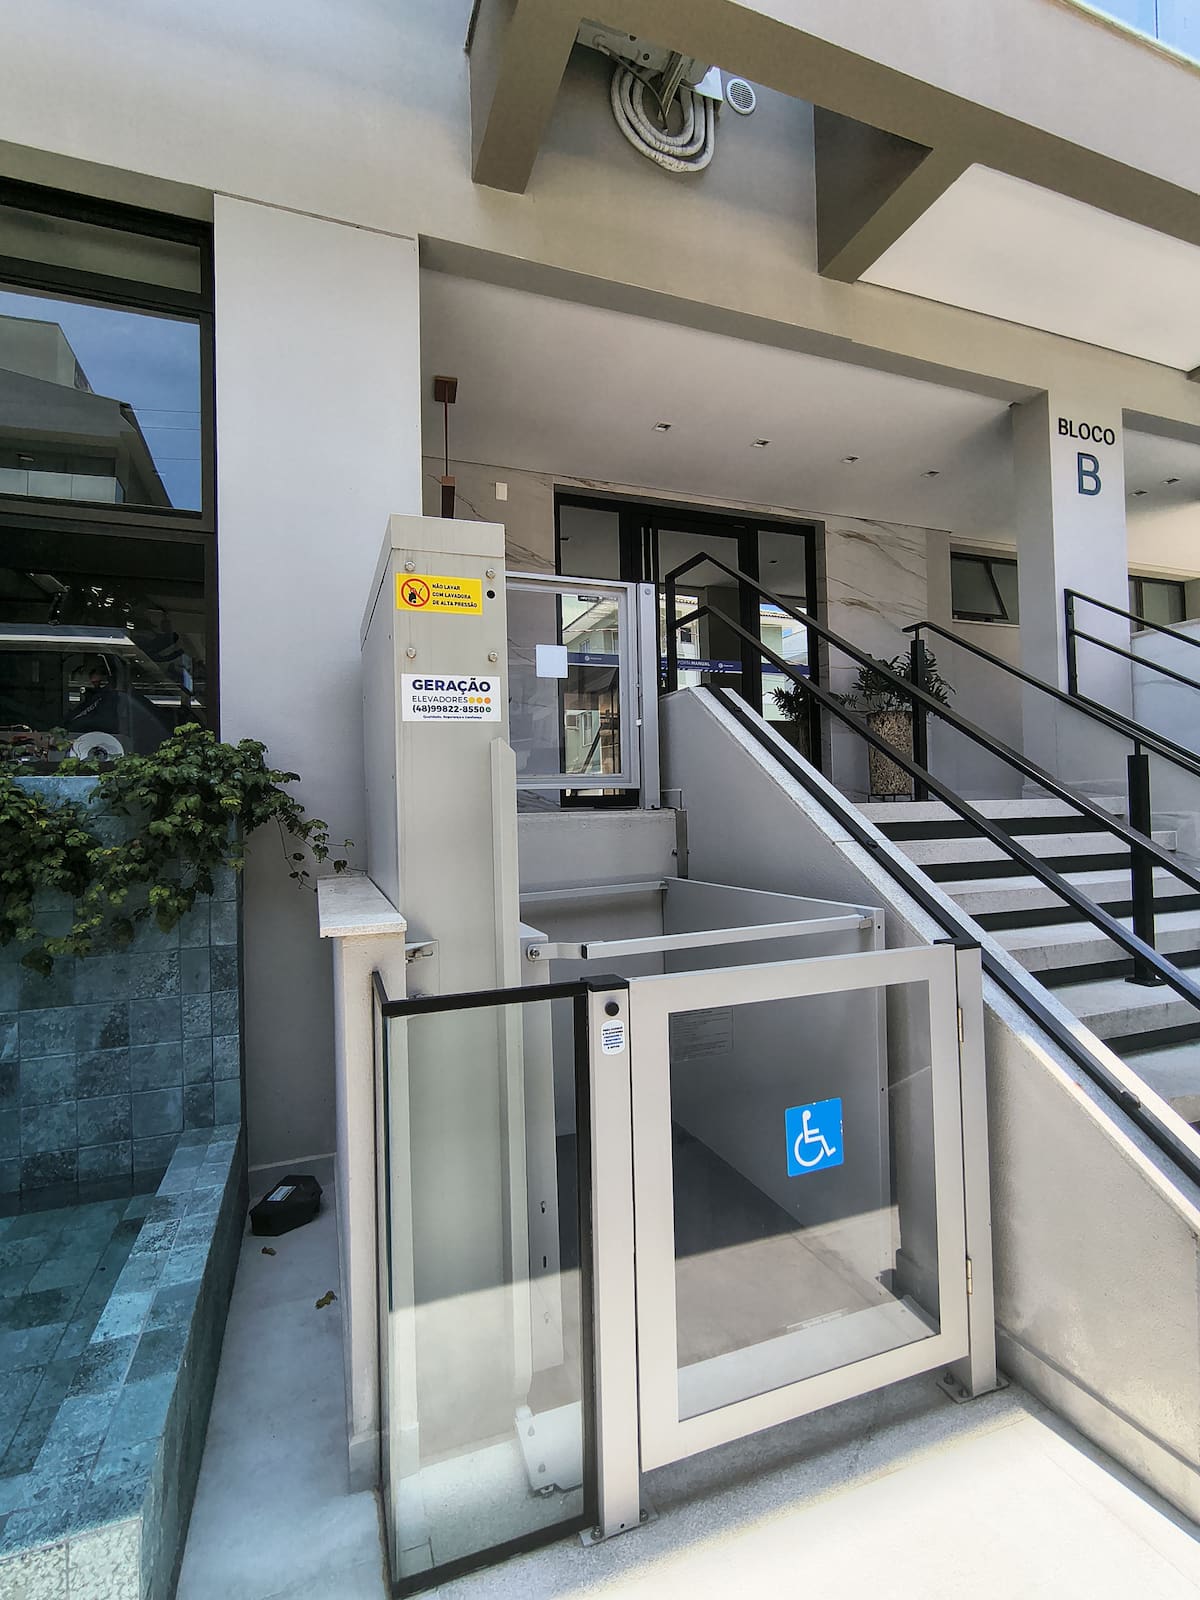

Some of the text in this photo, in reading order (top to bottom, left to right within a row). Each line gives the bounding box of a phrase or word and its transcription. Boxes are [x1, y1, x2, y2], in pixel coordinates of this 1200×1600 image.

[1058, 417, 1115, 445] BLOCO
[1077, 452, 1102, 496] B
[412, 677, 491, 695] GERAÇÃO
[412, 695, 468, 703] ELEVADORES
[412, 704, 485, 713] (48)99822-8550
